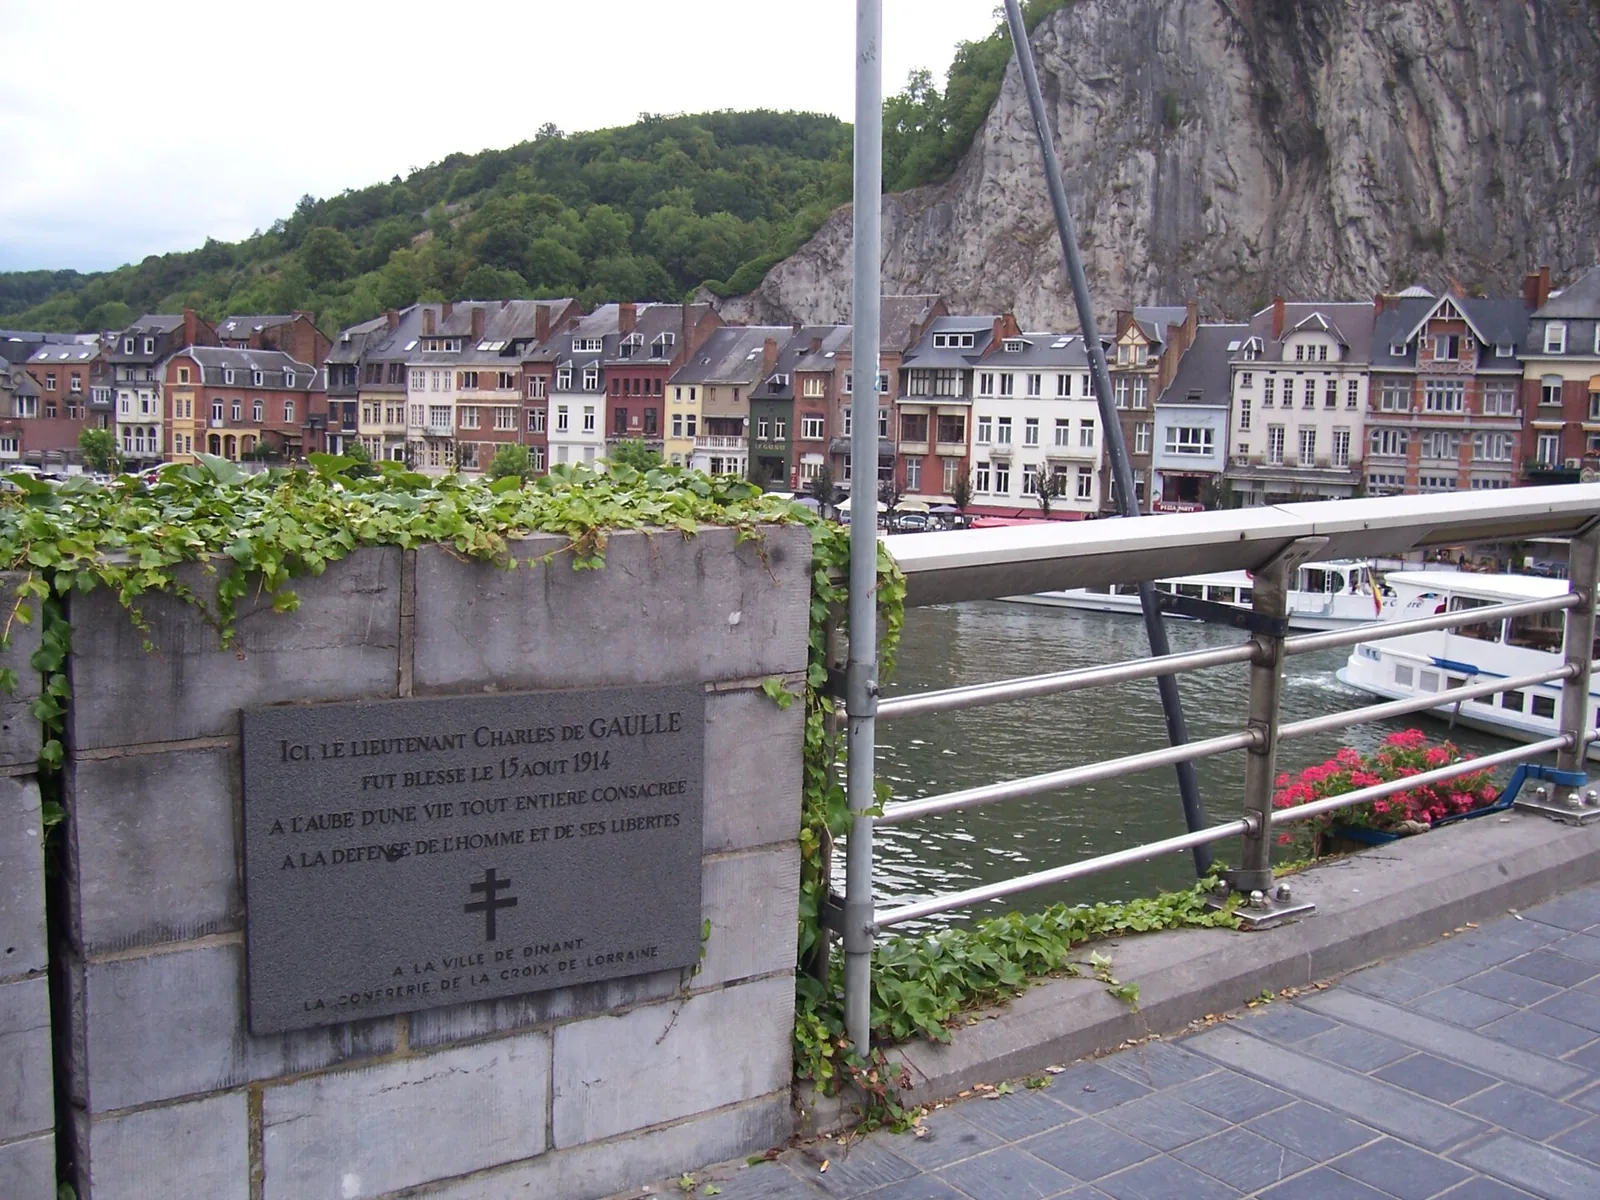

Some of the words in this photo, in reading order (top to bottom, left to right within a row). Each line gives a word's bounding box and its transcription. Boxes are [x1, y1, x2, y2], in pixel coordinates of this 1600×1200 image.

[321, 743, 345, 760] LE
[351, 733, 467, 757] LIEUTENANT
[473, 726, 556, 748] CHARLES
[561, 724, 585, 742] DE
[588, 712, 682, 739] GAULLE
[362, 774, 397, 791] FUT
[403, 768, 466, 788] BLESSE
[471, 766, 494, 783] LE
[500, 757, 520, 780] 15
[520, 760, 569, 778] AOUT
[573, 750, 612, 773] 1914
[268, 819, 285, 836] A
[291, 812, 355, 834] L'AUBE
[362, 806, 418, 826] D'UNE
[423, 803, 453, 819] VIE
[460, 798, 509, 816] TOUT
[515, 790, 588, 811] ENTIERE
[591, 780, 688, 803] CONSACREE
[281, 855, 296, 871] A
[301, 852, 327, 868] LA
[331, 842, 411, 865] DEFENSE
[415, 840, 439, 856] DE
[443, 830, 525, 852] L'HOMME
[530, 827, 550, 843] ET
[554, 825, 575, 840] DE
[580, 821, 606, 838] SES
[611, 813, 681, 834] LIBERTES
[304, 999, 325, 1012] LA
[338, 982, 431, 1006] CONFRERIE
[440, 978, 461, 991] DE
[471, 973, 490, 986] LA
[500, 964, 550, 980] CROIX
[558, 960, 577, 972] DE
[587, 946, 659, 968] LORRAINE
[392, 966, 404, 977] A
[414, 962, 437, 975] LA
[443, 953, 485, 969] VILLE
[495, 949, 514, 962] DE
[523, 938, 584, 958] DINANT
